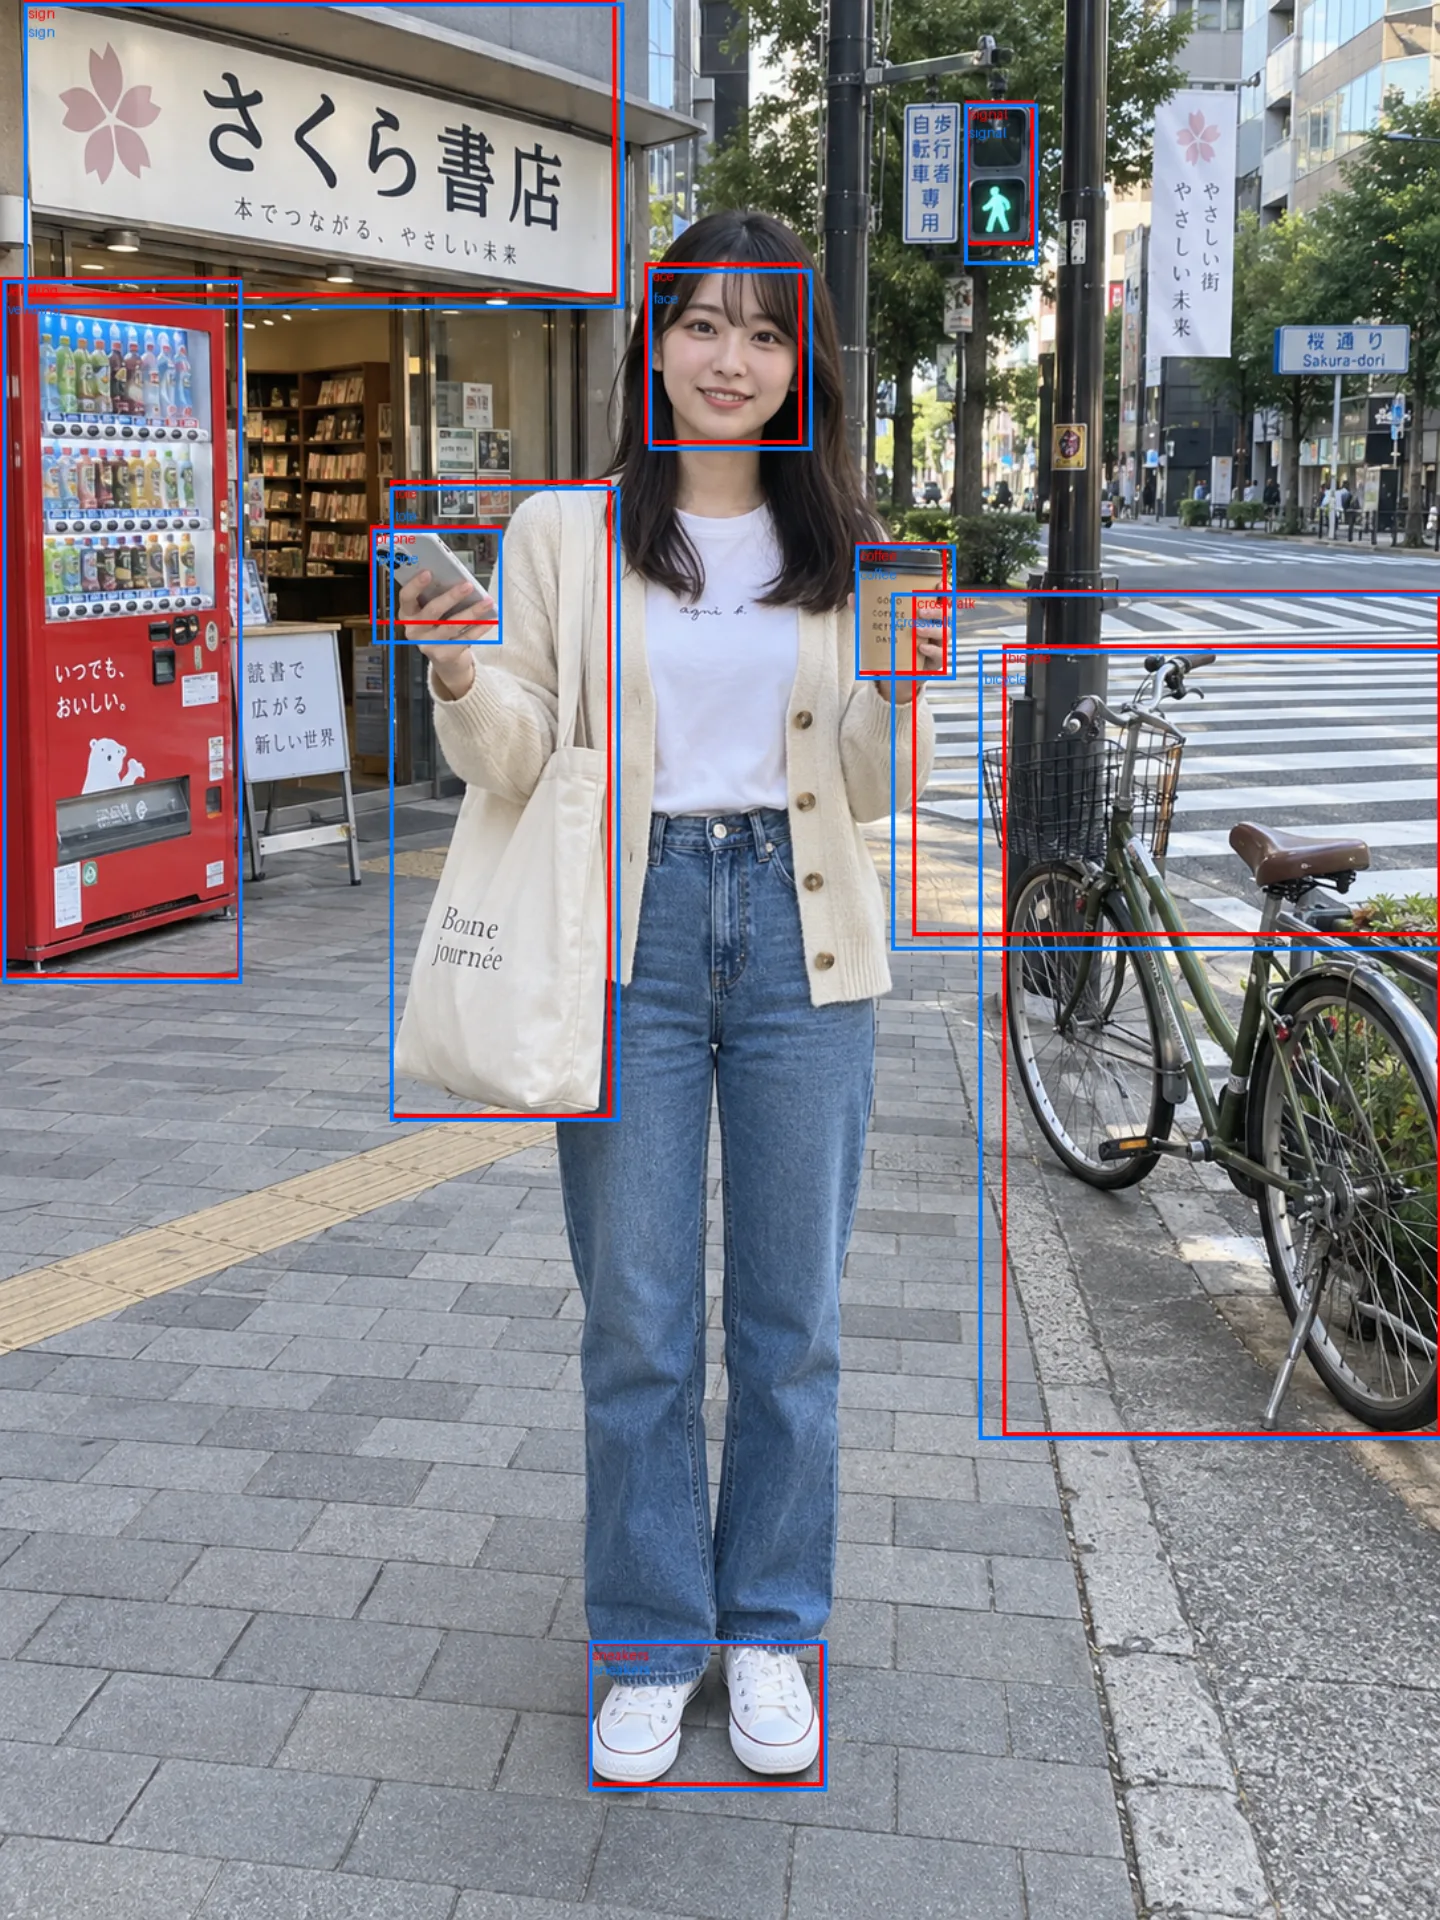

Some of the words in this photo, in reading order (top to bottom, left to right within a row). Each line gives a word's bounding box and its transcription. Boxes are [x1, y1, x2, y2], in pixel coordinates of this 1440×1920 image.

[203, 72, 562, 231] さくら書店
[911, 114, 931, 184] 自転車
[933, 114, 952, 184] 歩行者
[234, 196, 518, 266] 本でつながる、やさしい未来
[1201, 182, 1220, 292] やさしい街
[1171, 181, 1192, 338] やさしい未来
[1307, 332, 1383, 351] 桜通り
[1303, 353, 1385, 368] Sakura-dori
[55, 657, 125, 684] いつでも、
[247, 660, 305, 684] 読書で
[56, 692, 127, 719] おいしい。
[252, 696, 307, 719] 広がる
[254, 727, 336, 755] 新しい世界
[431, 936, 504, 971] journée
